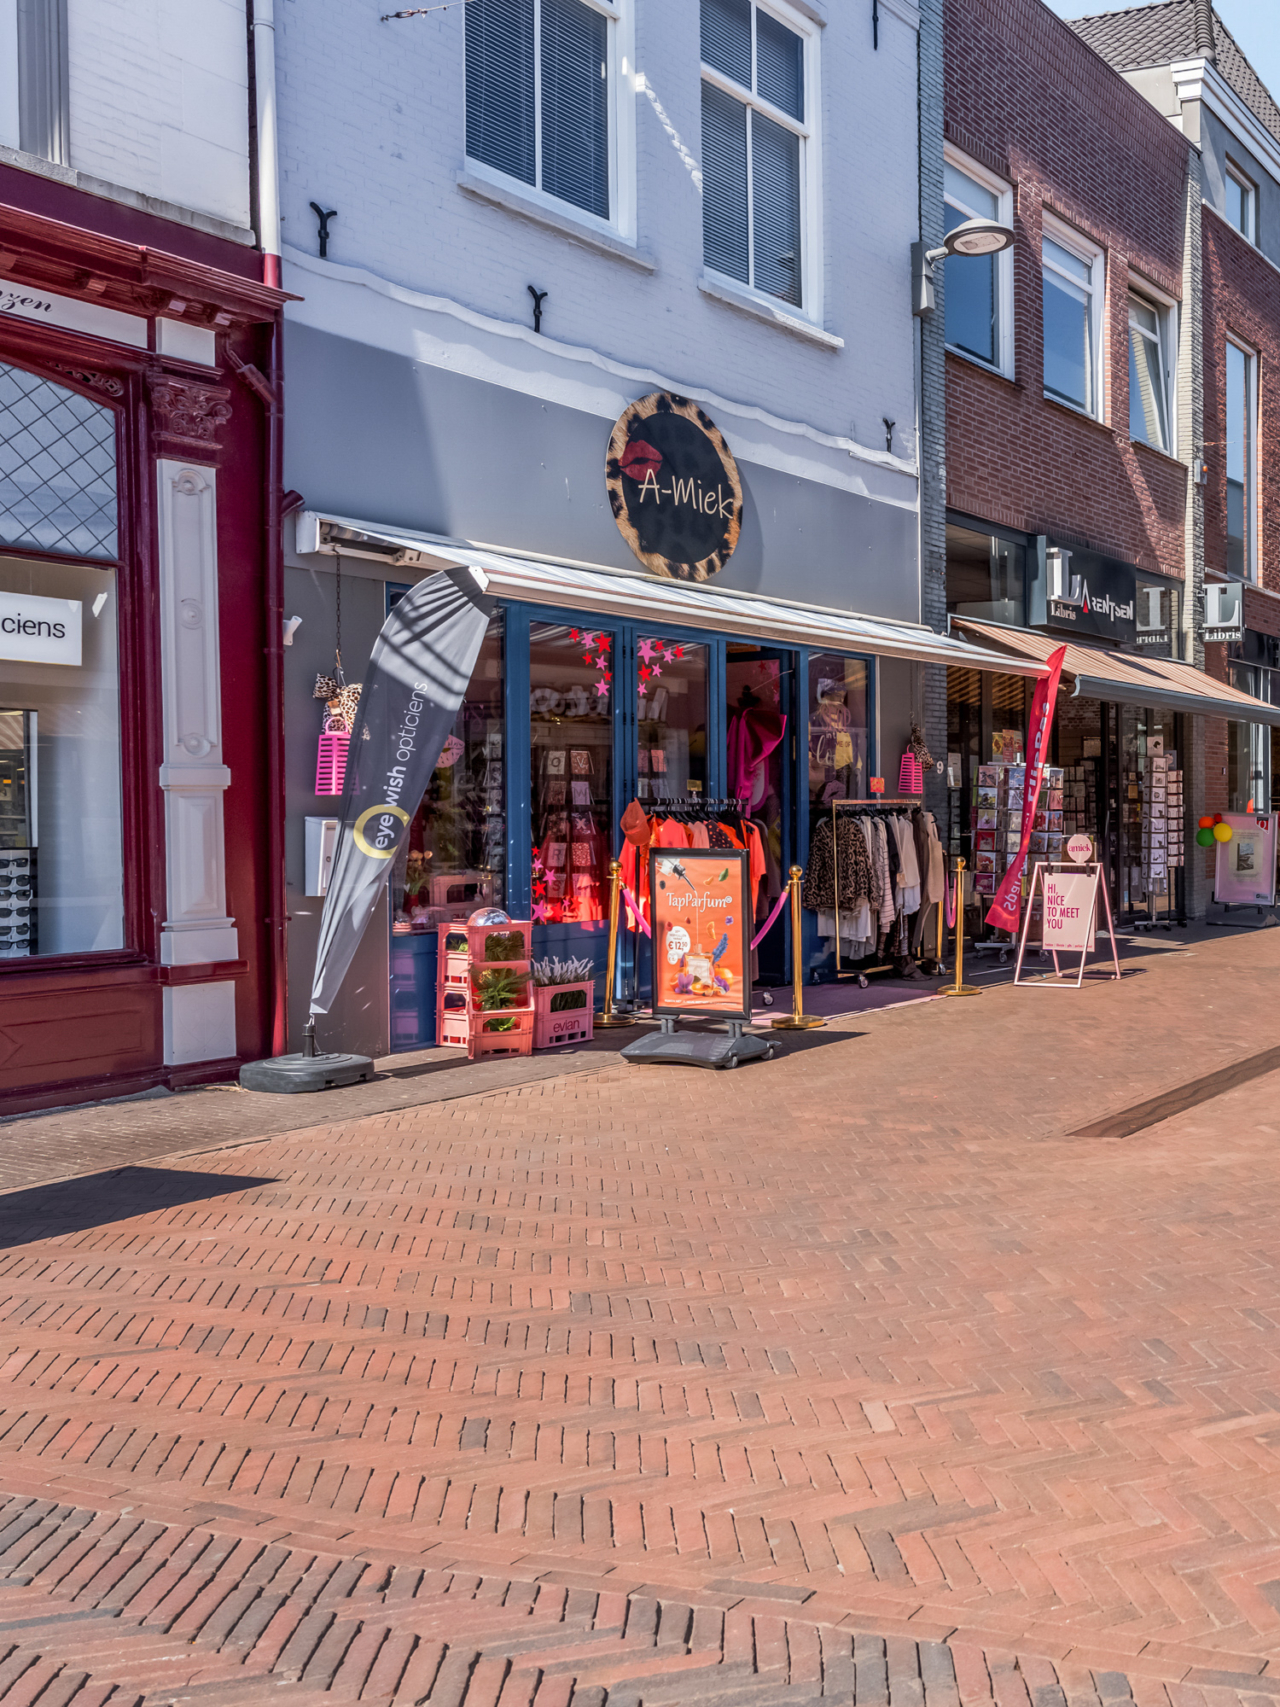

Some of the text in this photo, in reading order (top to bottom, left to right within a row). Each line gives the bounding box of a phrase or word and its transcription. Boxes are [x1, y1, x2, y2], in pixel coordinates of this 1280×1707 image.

[0, 290, 53, 313] zen
[638, 468, 734, 519] A-Miek
[1051, 600, 1077, 621] Libris
[1205, 628, 1241, 641] Libris
[383, 765, 407, 807] wish
[396, 682, 428, 762] opticiens
[936, 760, 944, 774] 9
[1047, 883, 1059, 896] HI,
[1047, 895, 1065, 906] NICE
[1047, 906, 1080, 918] TO MEET
[1046, 918, 1063, 930] YOU
[553, 1018, 580, 1032] evian
